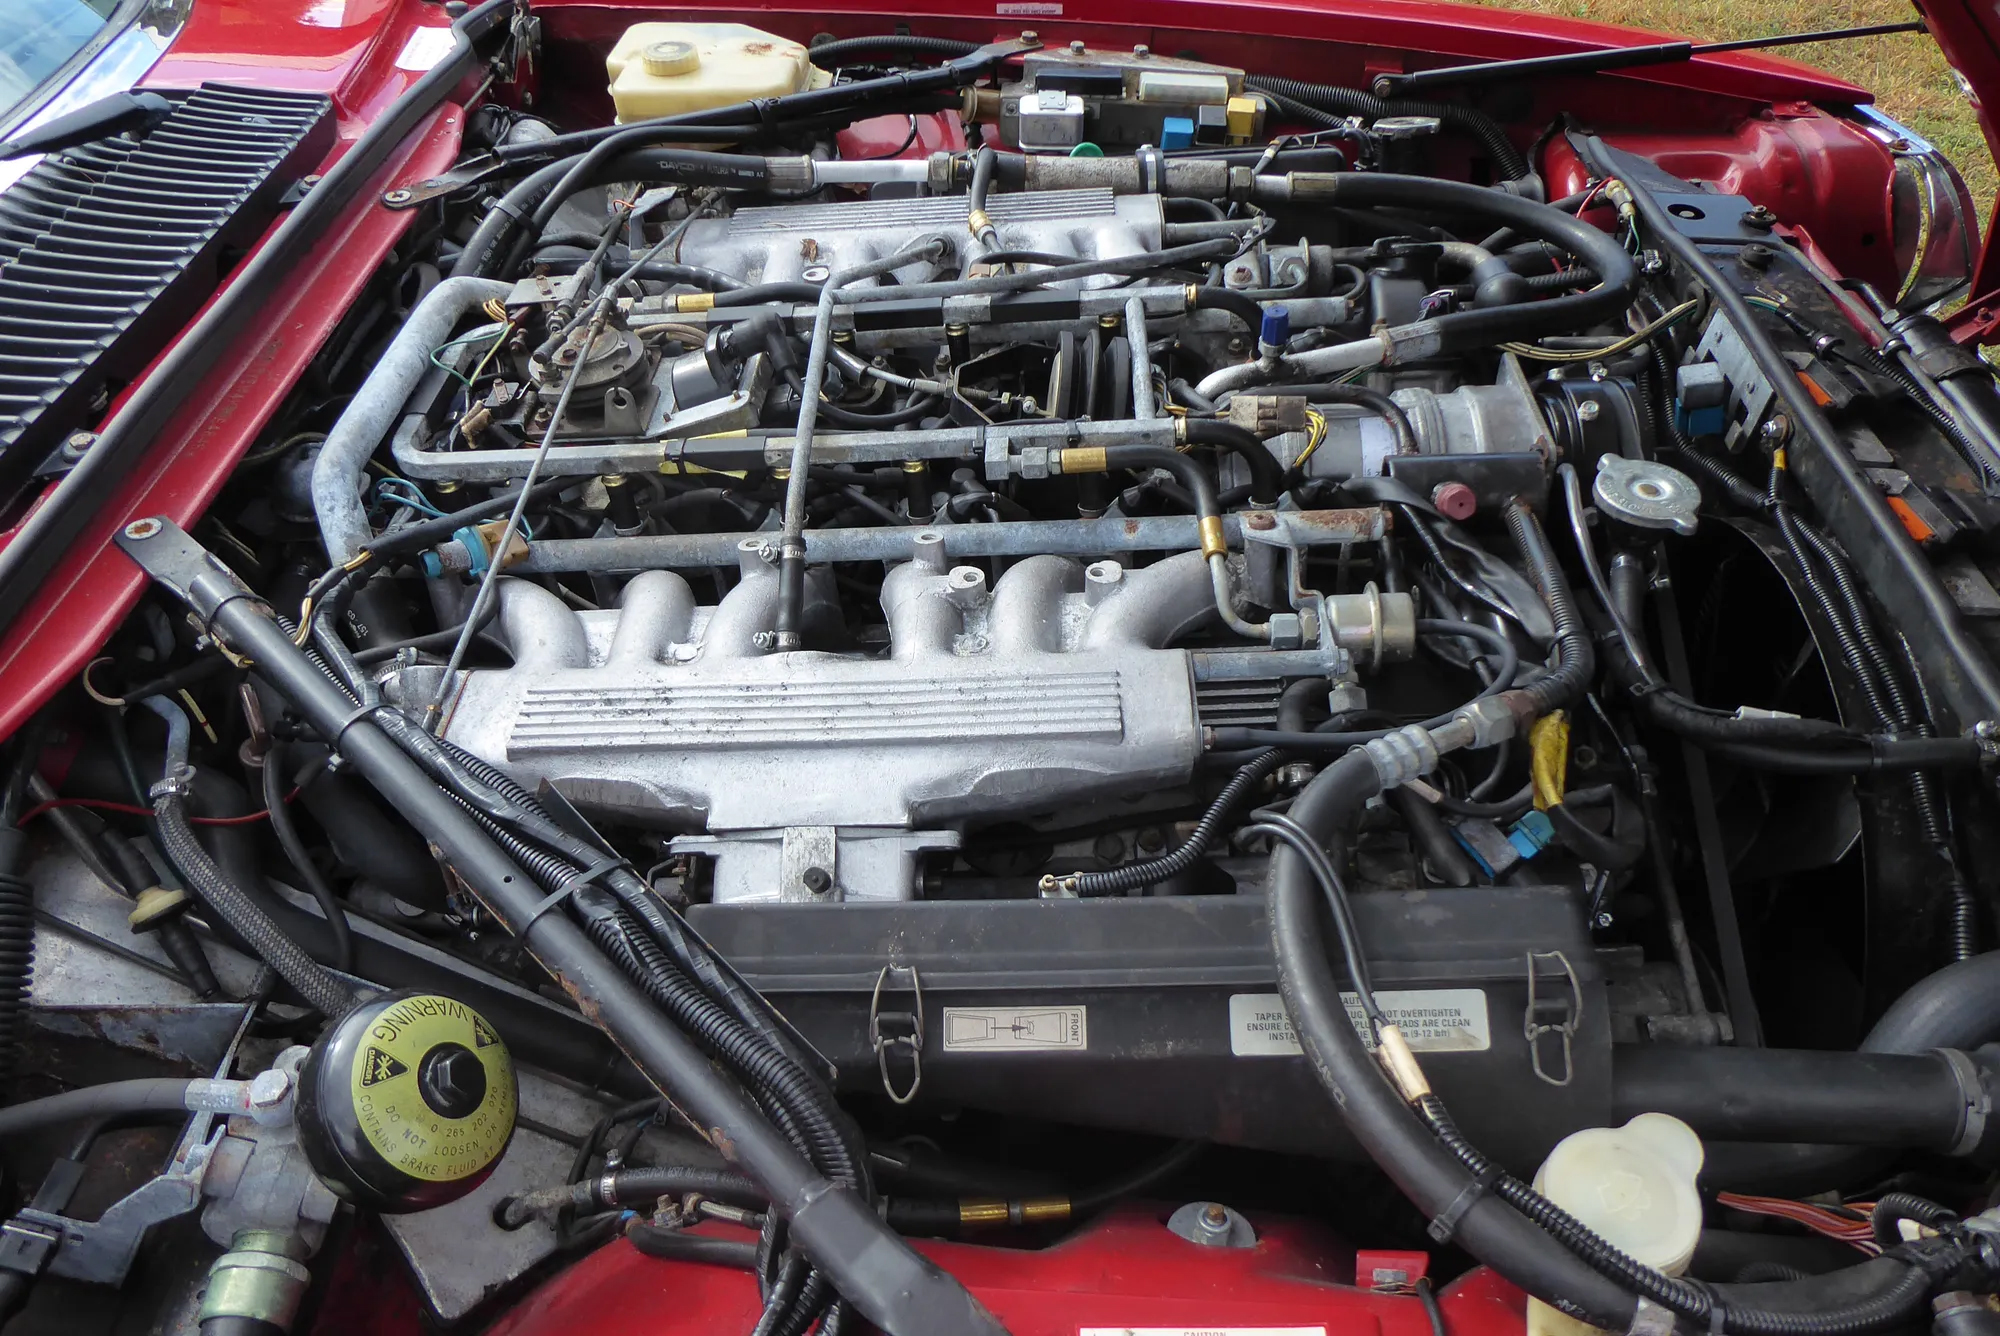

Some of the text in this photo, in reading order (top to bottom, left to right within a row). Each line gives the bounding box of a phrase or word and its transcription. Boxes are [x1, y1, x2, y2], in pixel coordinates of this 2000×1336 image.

[372, 998, 470, 1042] WARNING
[1070, 1013, 1079, 1042] FRONT
[1246, 1022, 1281, 1031] ENSURE
[1392, 1019, 1420, 1029] READS
[1422, 1019, 1439, 1028] ARE
[1441, 1018, 1471, 1027] CLEAN
[1254, 1012, 1283, 1021] TAPER
[1400, 1007, 1462, 1018] OVERTIGHTEN
[385, 1104, 401, 1123] DO
[402, 1128, 427, 1149] NOT
[434, 1138, 480, 1157] LOOSEN
[485, 1121, 497, 1138] OR
[446, 1127, 465, 1137] 265
[472, 1113, 488, 1131] 202
[488, 1086, 498, 1107] 070
[359, 1094, 397, 1153] CONTAINS
[400, 1152, 439, 1176] BRAKE
[447, 1159, 477, 1176] FLUID
[483, 1145, 494, 1160] AT
